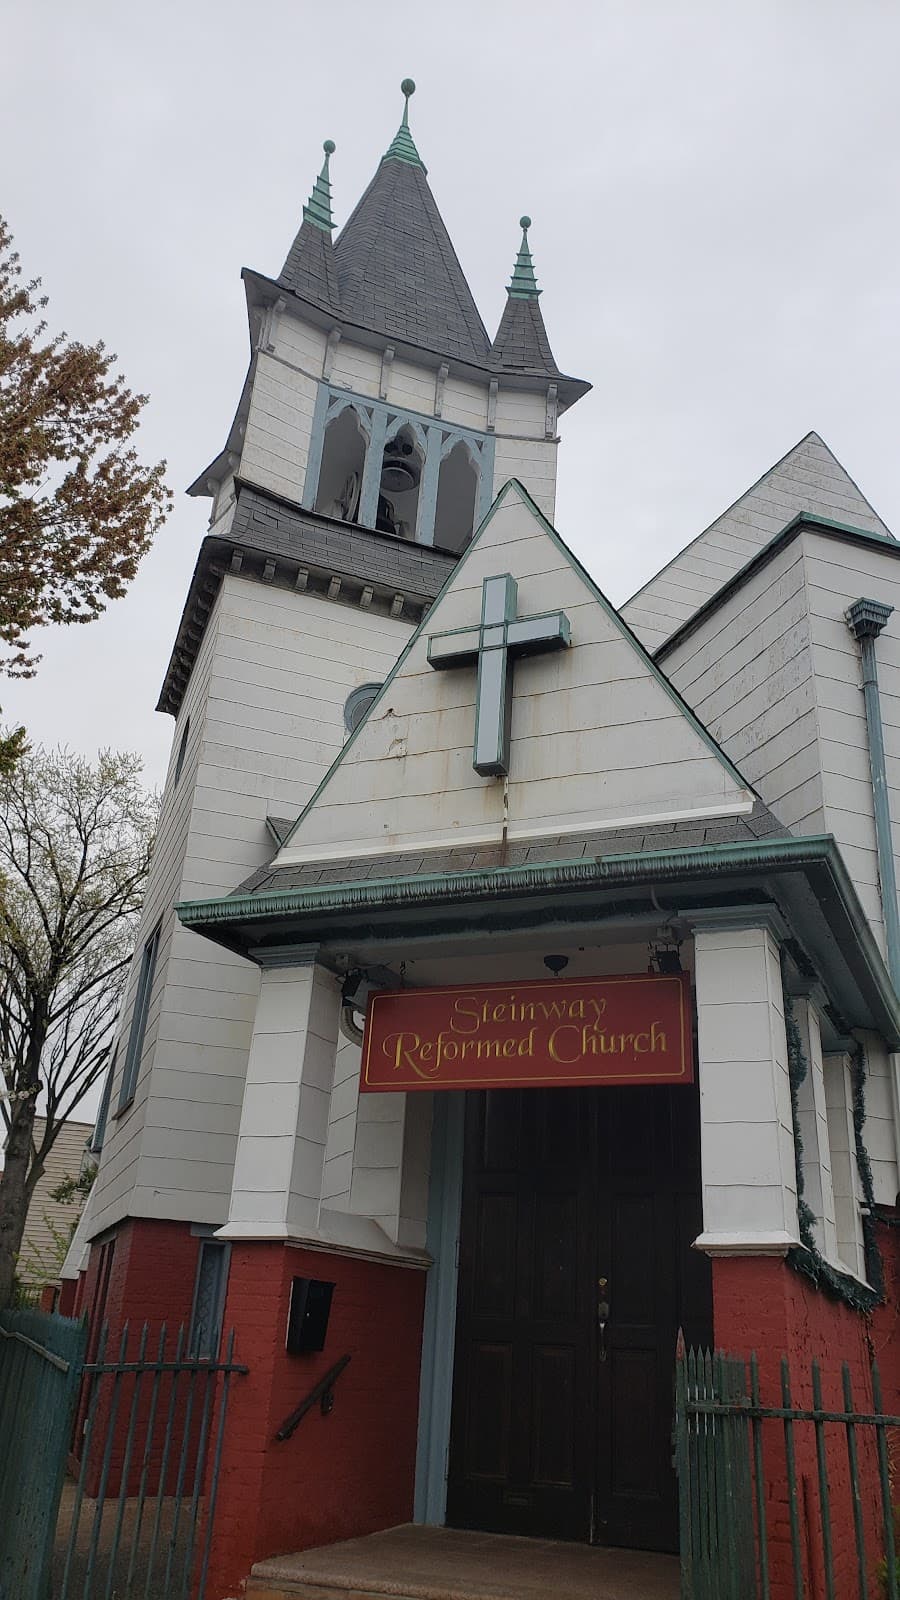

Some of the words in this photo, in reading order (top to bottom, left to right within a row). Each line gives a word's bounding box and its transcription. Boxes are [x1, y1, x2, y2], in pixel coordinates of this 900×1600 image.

[450, 995, 607, 1034] Steinway
[382, 1027, 539, 1079] Reformed
[548, 1021, 667, 1064] Church
